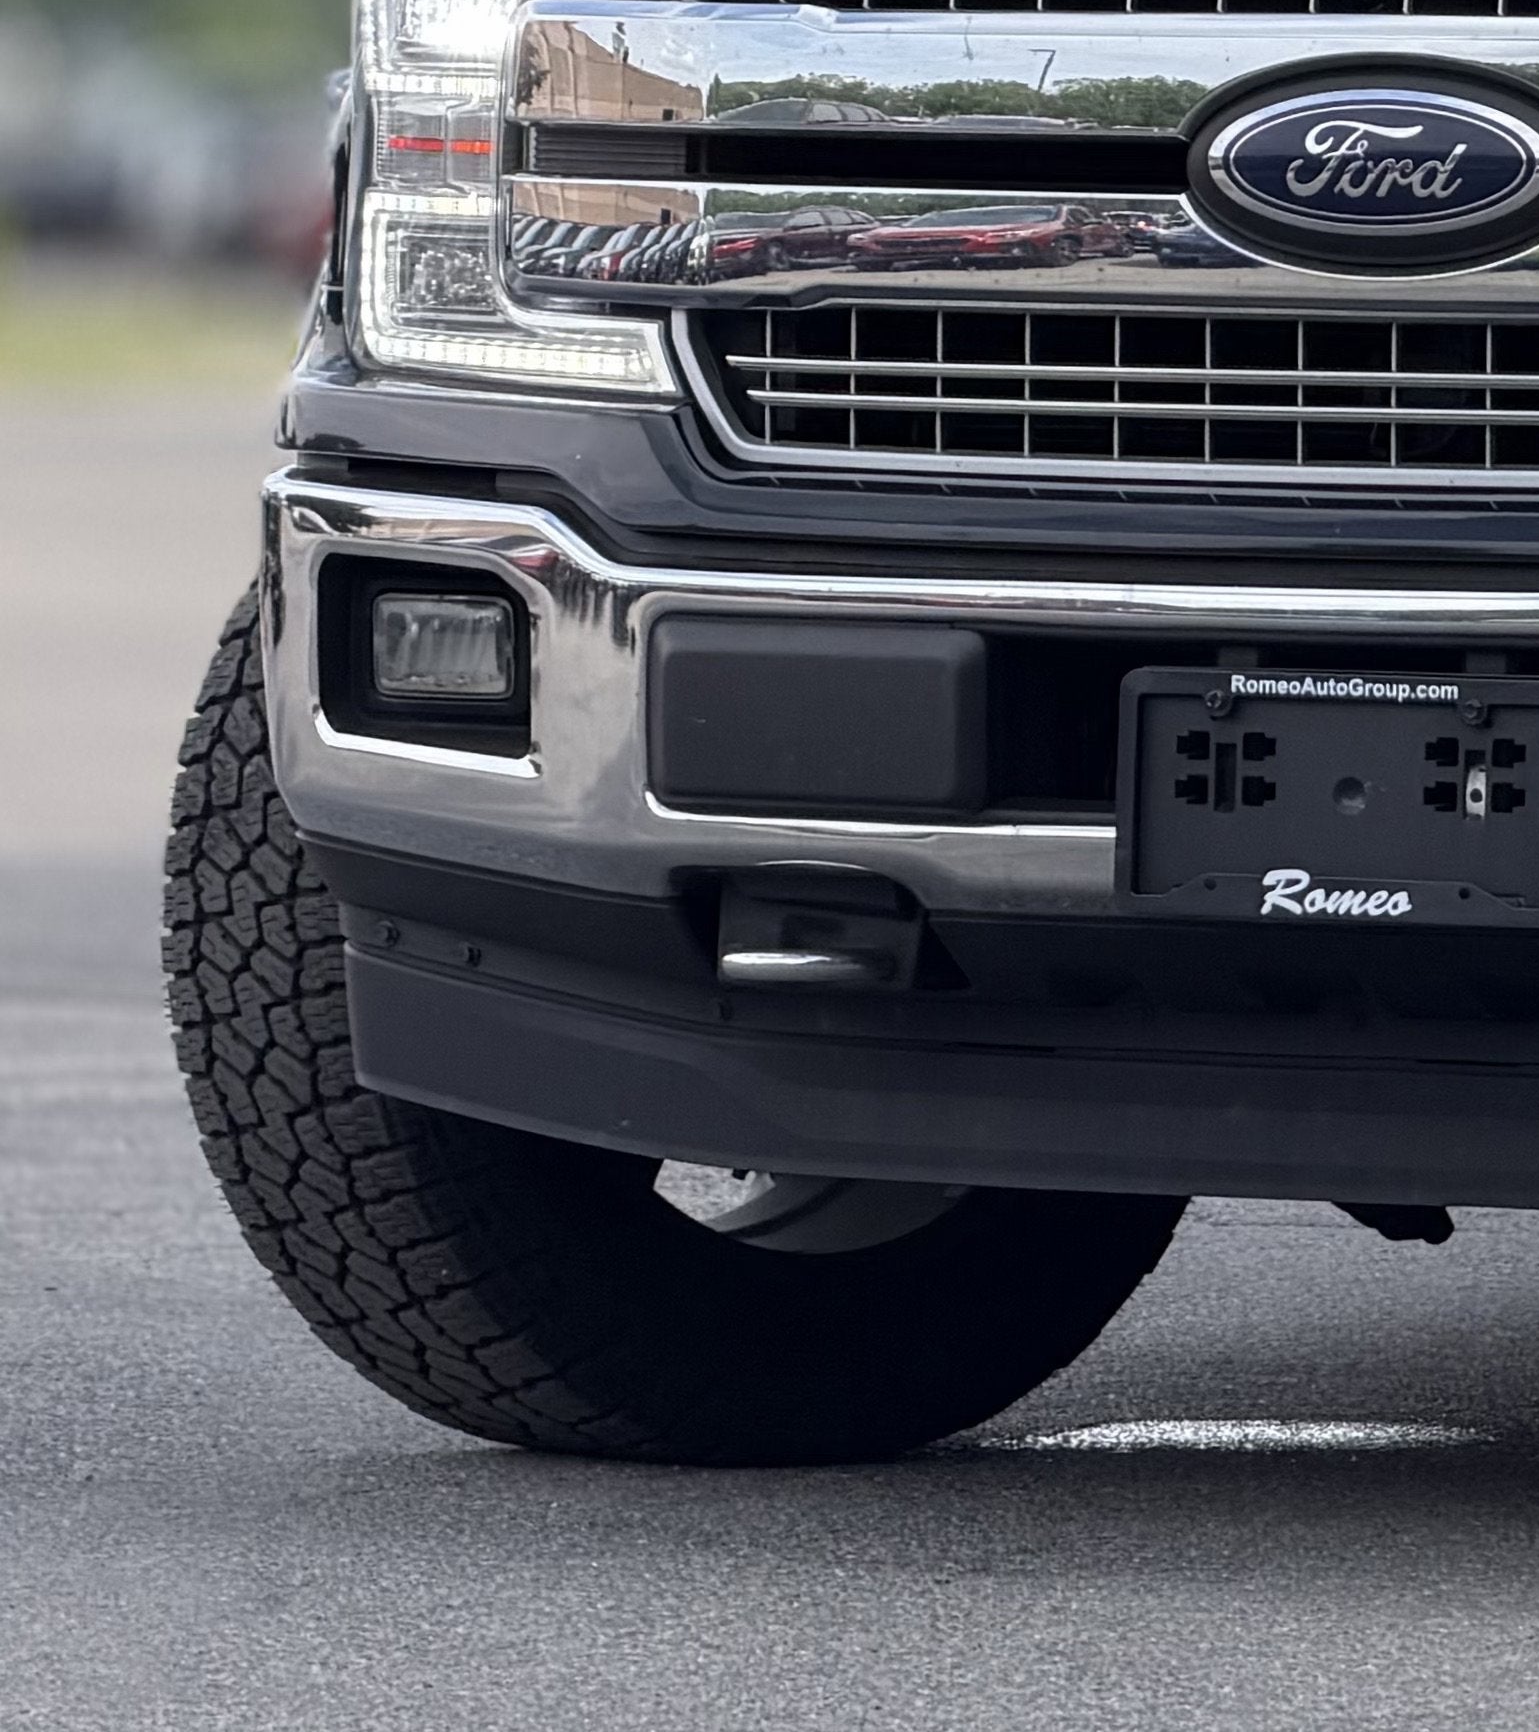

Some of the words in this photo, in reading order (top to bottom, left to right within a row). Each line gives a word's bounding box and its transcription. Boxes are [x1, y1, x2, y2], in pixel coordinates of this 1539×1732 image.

[1286, 120, 1468, 199] Ford
[1230, 674, 1459, 702] RomeoAutoGroup.com
[1260, 869, 1413, 917] Romeo
